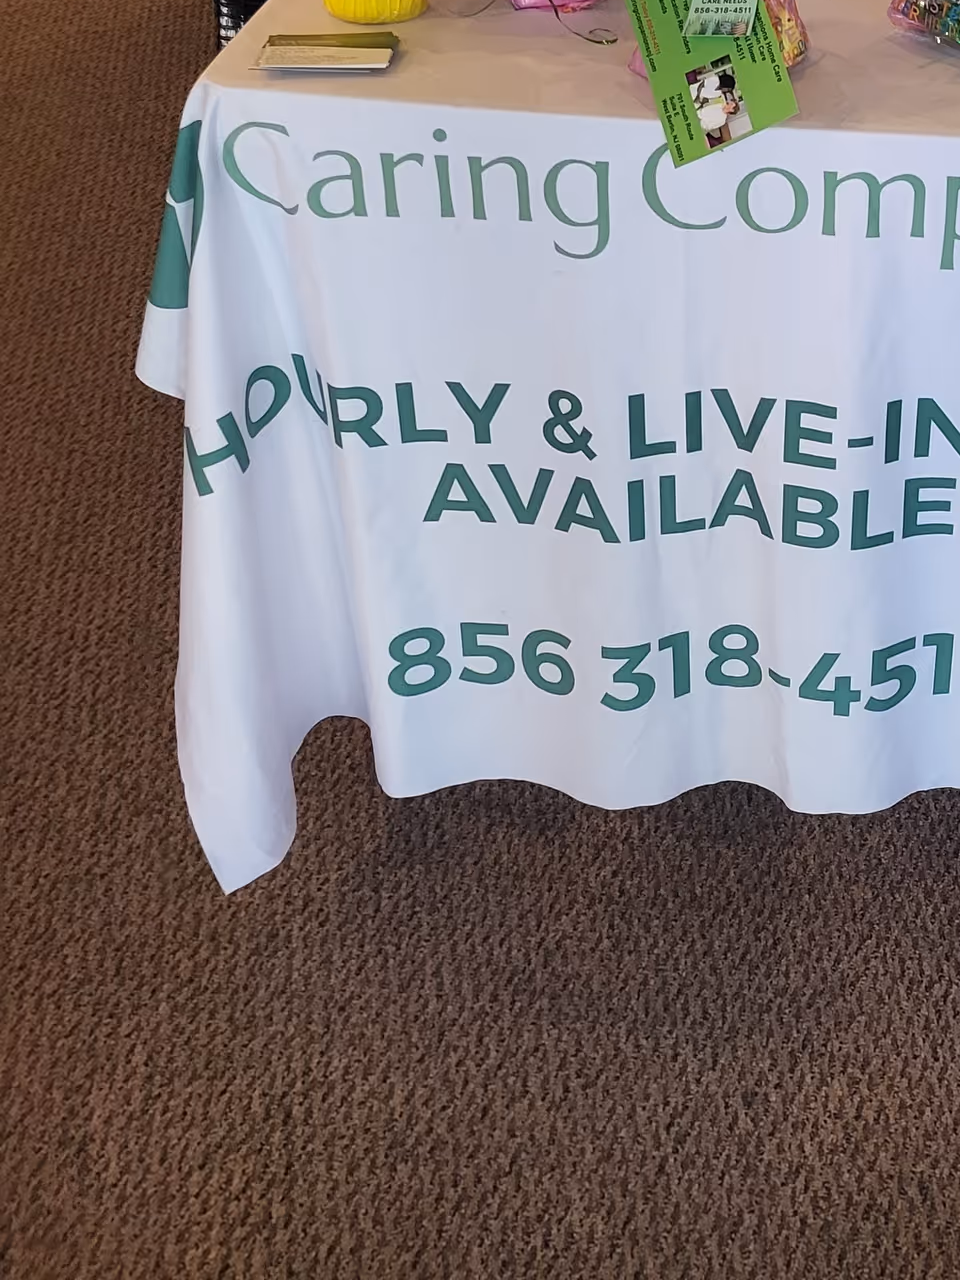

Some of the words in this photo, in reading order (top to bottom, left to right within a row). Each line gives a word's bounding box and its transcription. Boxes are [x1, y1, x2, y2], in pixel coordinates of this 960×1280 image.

[747, 42, 757, 64] Home
[758, 45, 767, 61] Care
[765, 41, 777, 64] Home
[773, 64, 782, 82] Care
[661, 98, 670, 115] West
[672, 134, 679, 143] NJ
[669, 95, 677, 111] Suite
[680, 104, 689, 122] South
[685, 122, 695, 141] Route
[221, 121, 611, 259] Caring
[184, 353, 511, 496] HOURLY
[542, 388, 595, 461] &
[422, 462, 958, 551] AVAILABLE
[386, 622, 576, 697] 856
